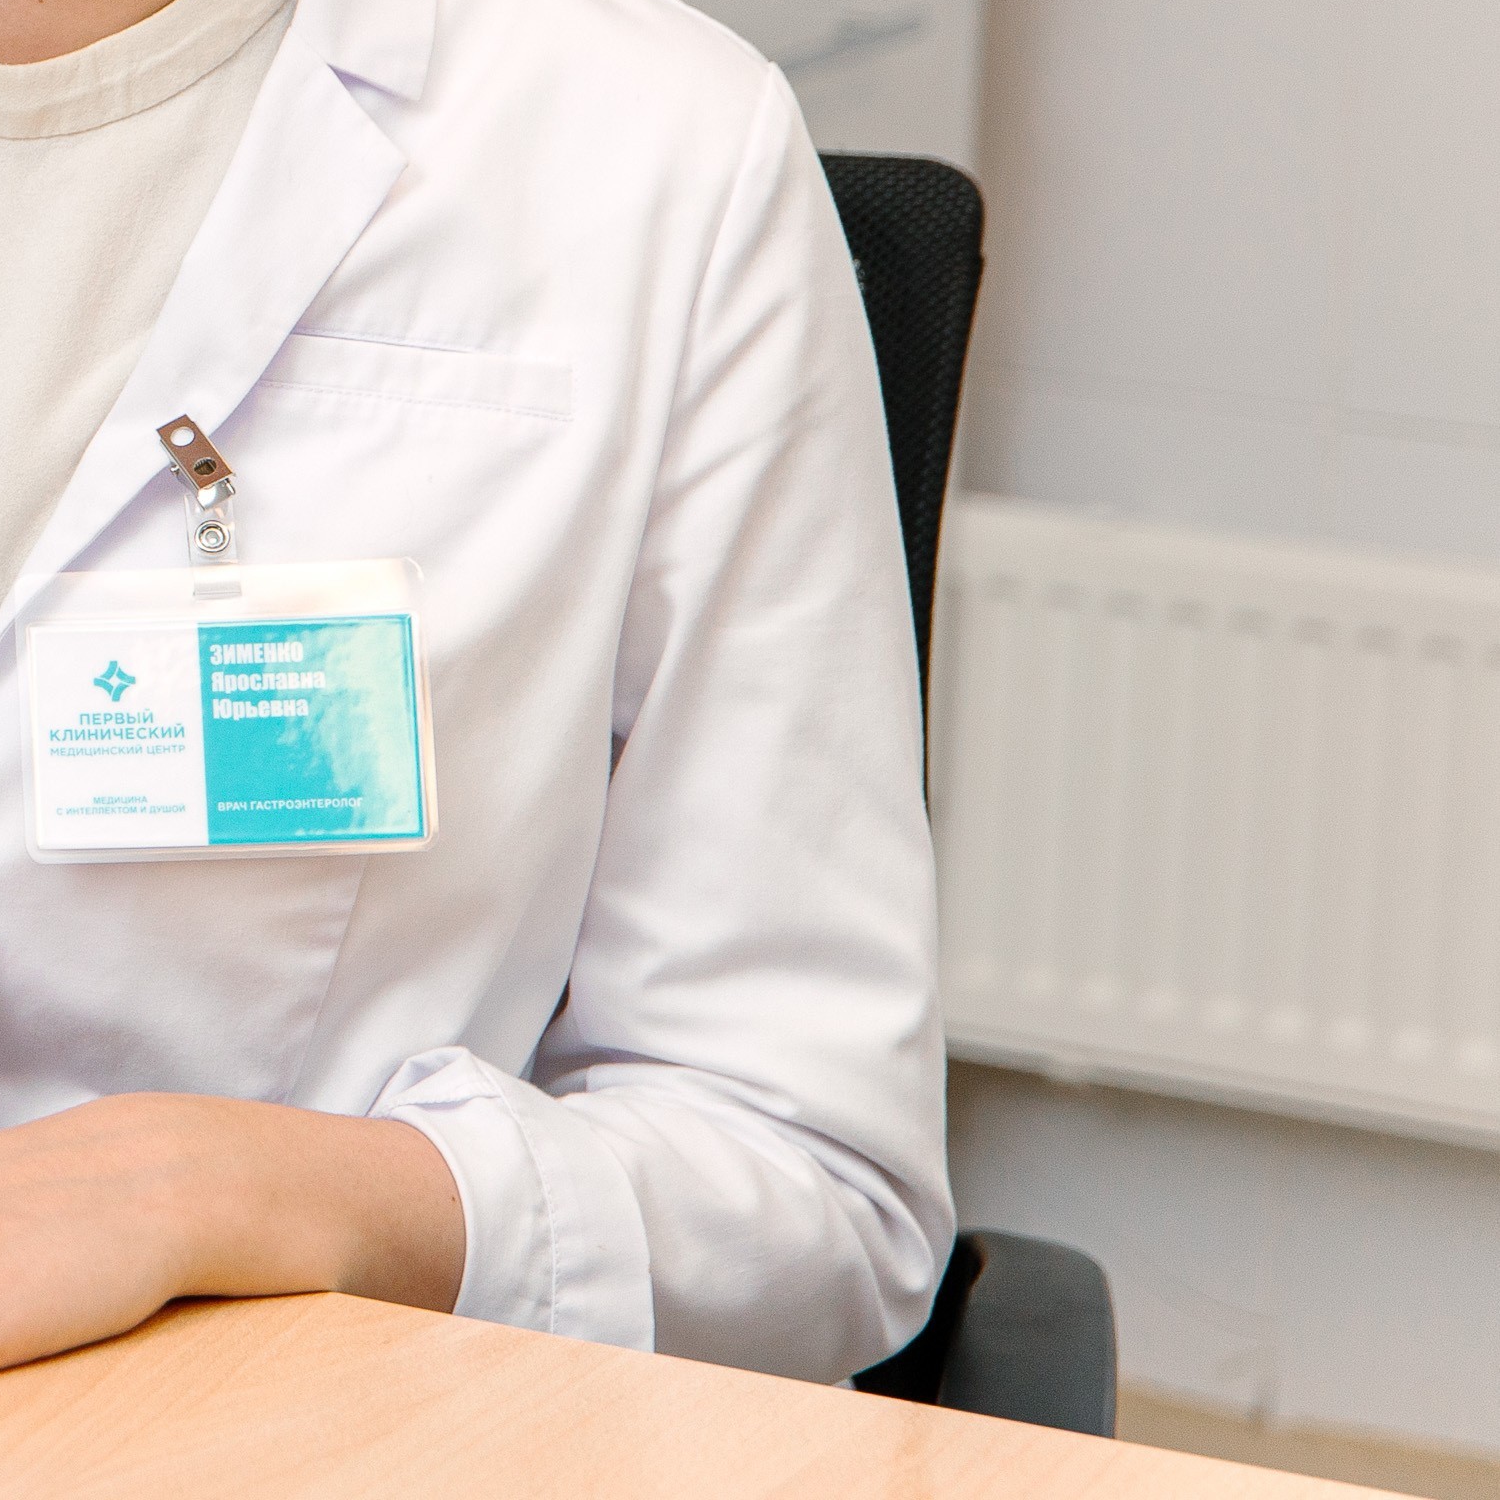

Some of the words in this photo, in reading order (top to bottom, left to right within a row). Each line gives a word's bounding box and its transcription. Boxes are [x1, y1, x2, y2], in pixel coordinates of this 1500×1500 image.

[209, 641, 304, 666] ЗИМЕНКО
[211, 671, 326, 694] Ярославна
[79, 707, 154, 726] ПЕРВЫЙ
[212, 698, 309, 720] Юрьевна
[49, 722, 186, 742] КЛИНИЧЕСКИЙ
[50, 744, 143, 757] МЕДИЦИНСКИЙ
[146, 743, 186, 756] ЦЕНТР
[56, 806, 63, 816] С
[66, 805, 138, 816] ИНТЕЛЛЕКТОМ
[140, 805, 147, 814] И
[149, 802, 186, 815] ДУШОЙ
[92, 795, 149, 806] МЕДИЦИНА
[217, 800, 248, 812] ВРАЧ
[250, 796, 364, 812] ГАСТРОЭНТЕРОЛОГ
